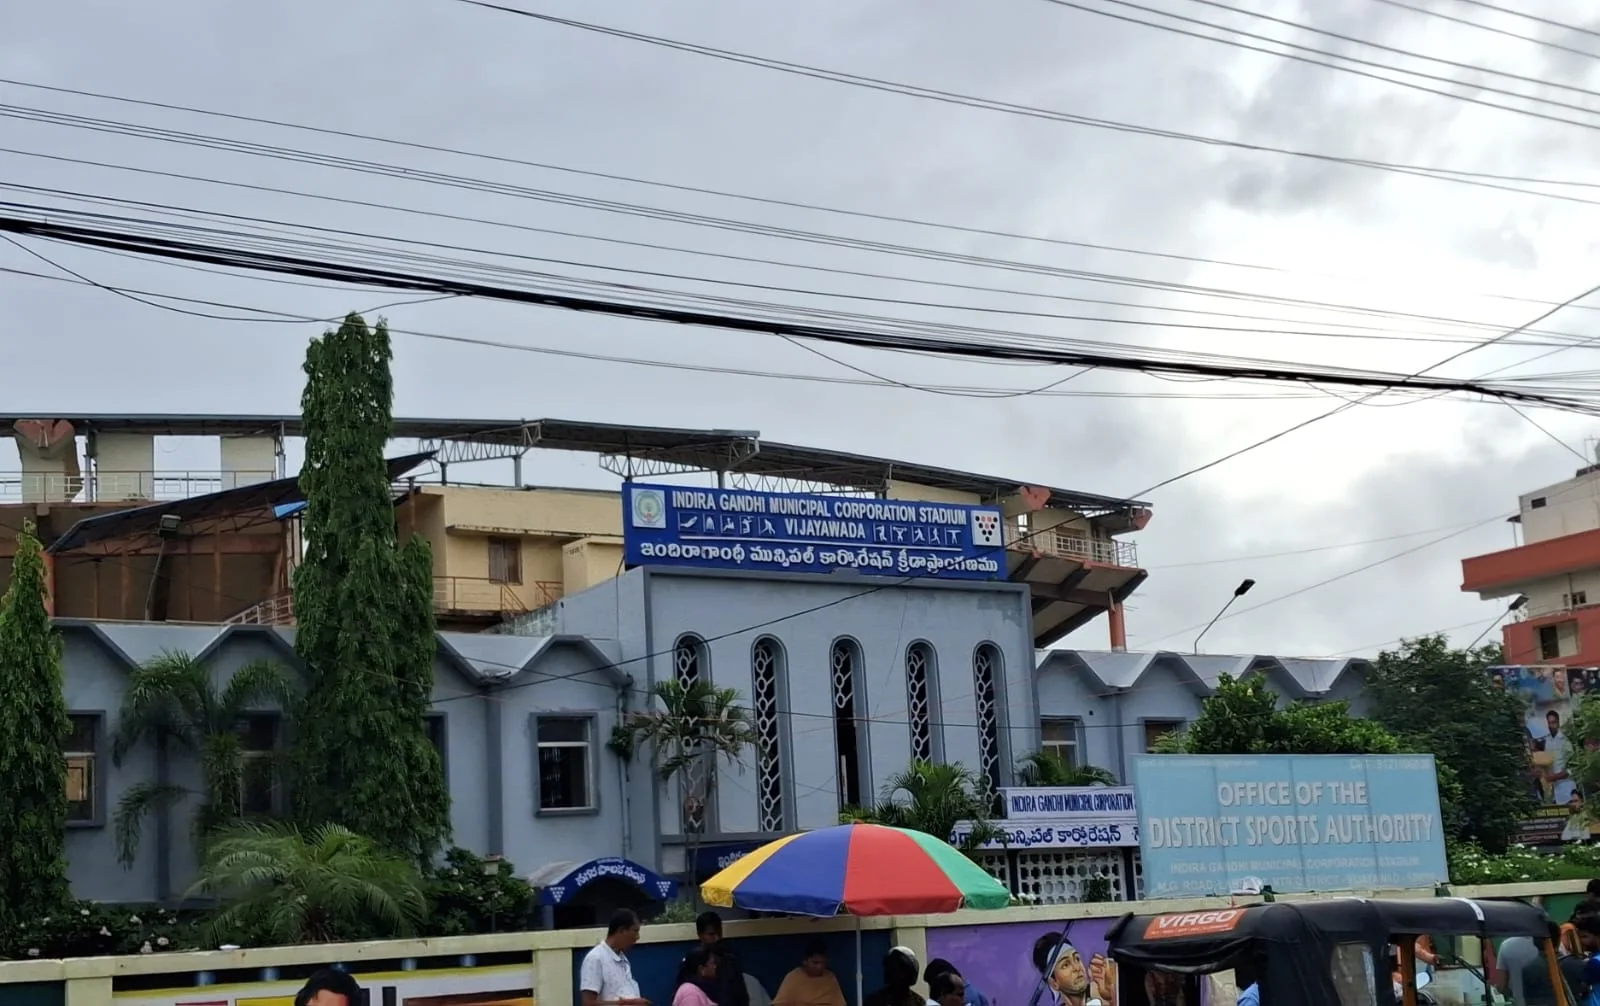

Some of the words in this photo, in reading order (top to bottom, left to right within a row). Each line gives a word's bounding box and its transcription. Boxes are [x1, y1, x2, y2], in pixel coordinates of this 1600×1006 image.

[672, 491, 716, 510] INDIRA
[719, 493, 766, 513] GANDHI
[769, 496, 831, 517] MUNICIPAL
[834, 501, 916, 523] CORPORATION
[919, 507, 967, 525] STADIUM
[784, 518, 866, 539] VIJAYAWADA
[640, 543, 745, 564] ఇందిరాగాంధీ
[1011, 795, 1037, 812] INDIRA
[1217, 782, 1290, 807] OFFICE
[1295, 781, 1322, 807] OF
[1328, 780, 1368, 806] THE
[1150, 816, 1240, 849] DISTRICT
[1245, 814, 1320, 847] SPORTS
[1324, 812, 1433, 845] AUTHORITY
[1159, 910, 1237, 928] VIRGO
